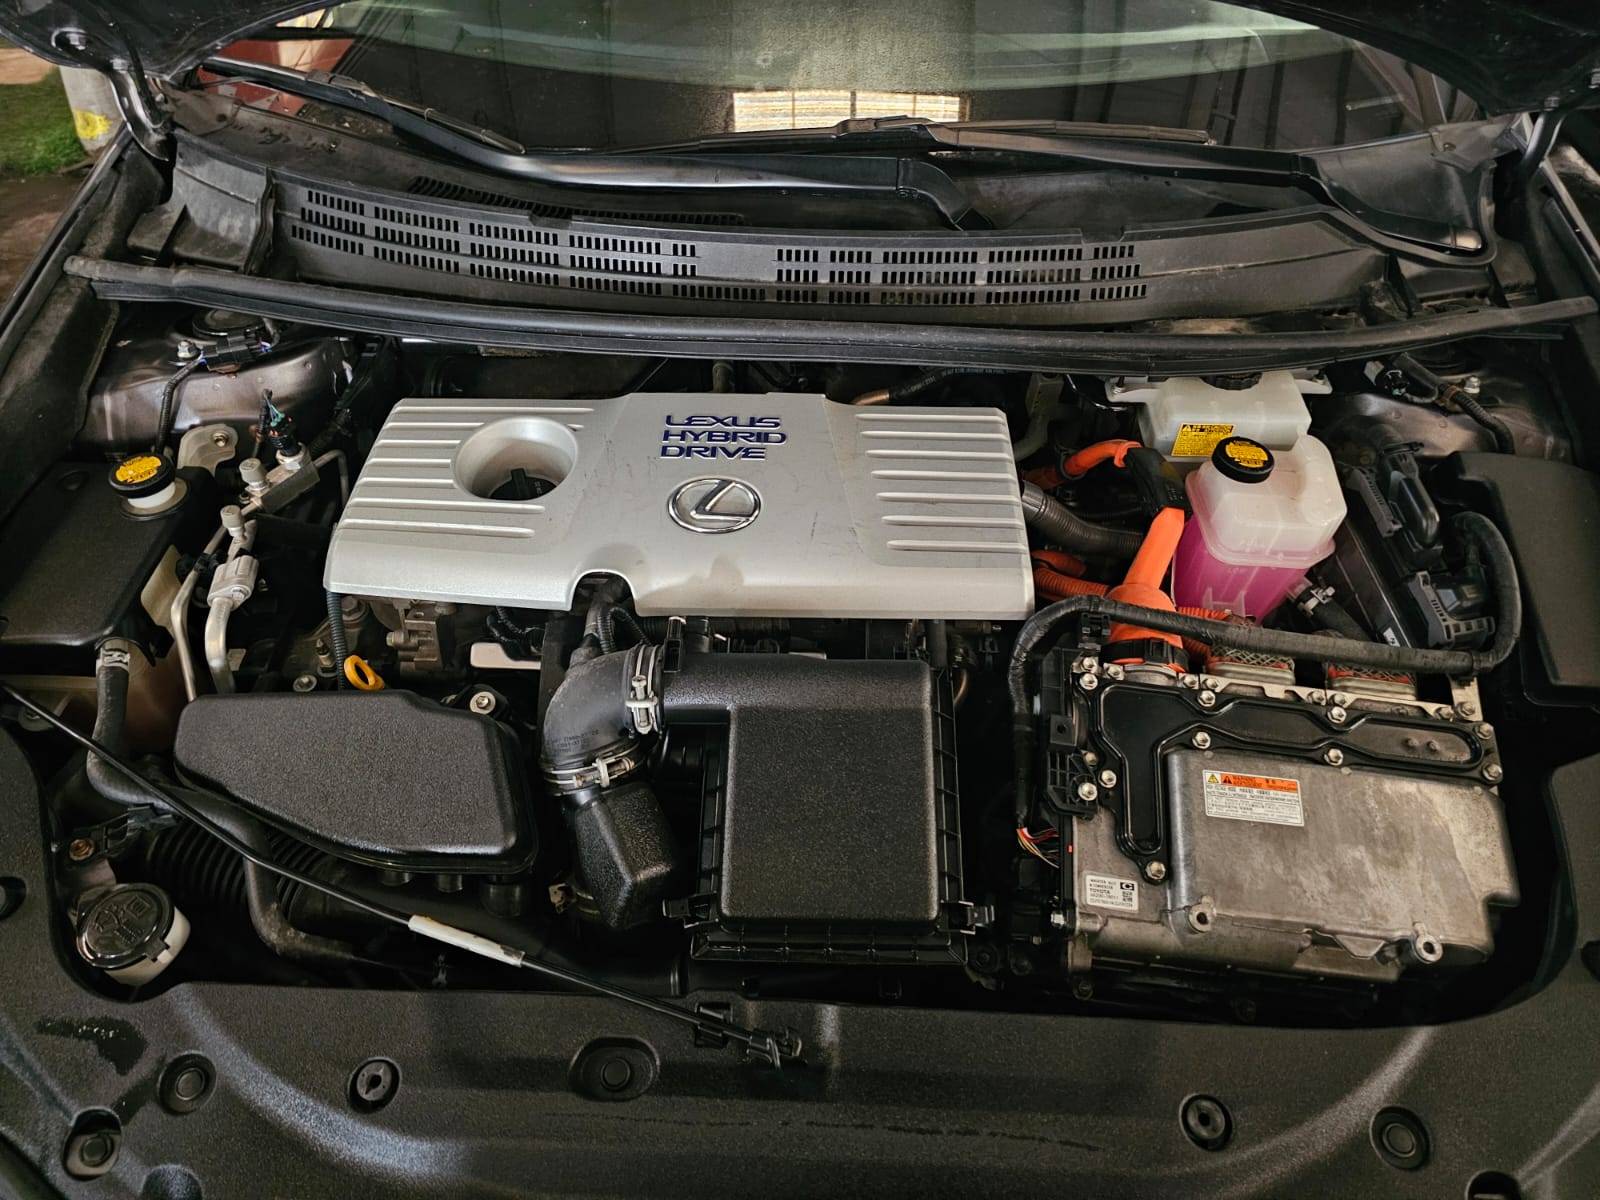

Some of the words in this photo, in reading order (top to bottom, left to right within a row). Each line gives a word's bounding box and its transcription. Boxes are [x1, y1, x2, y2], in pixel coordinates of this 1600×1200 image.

[665, 415, 781, 429] LEXUS
[662, 430, 788, 445] HYBRID
[660, 445, 766, 460] DRIVE
